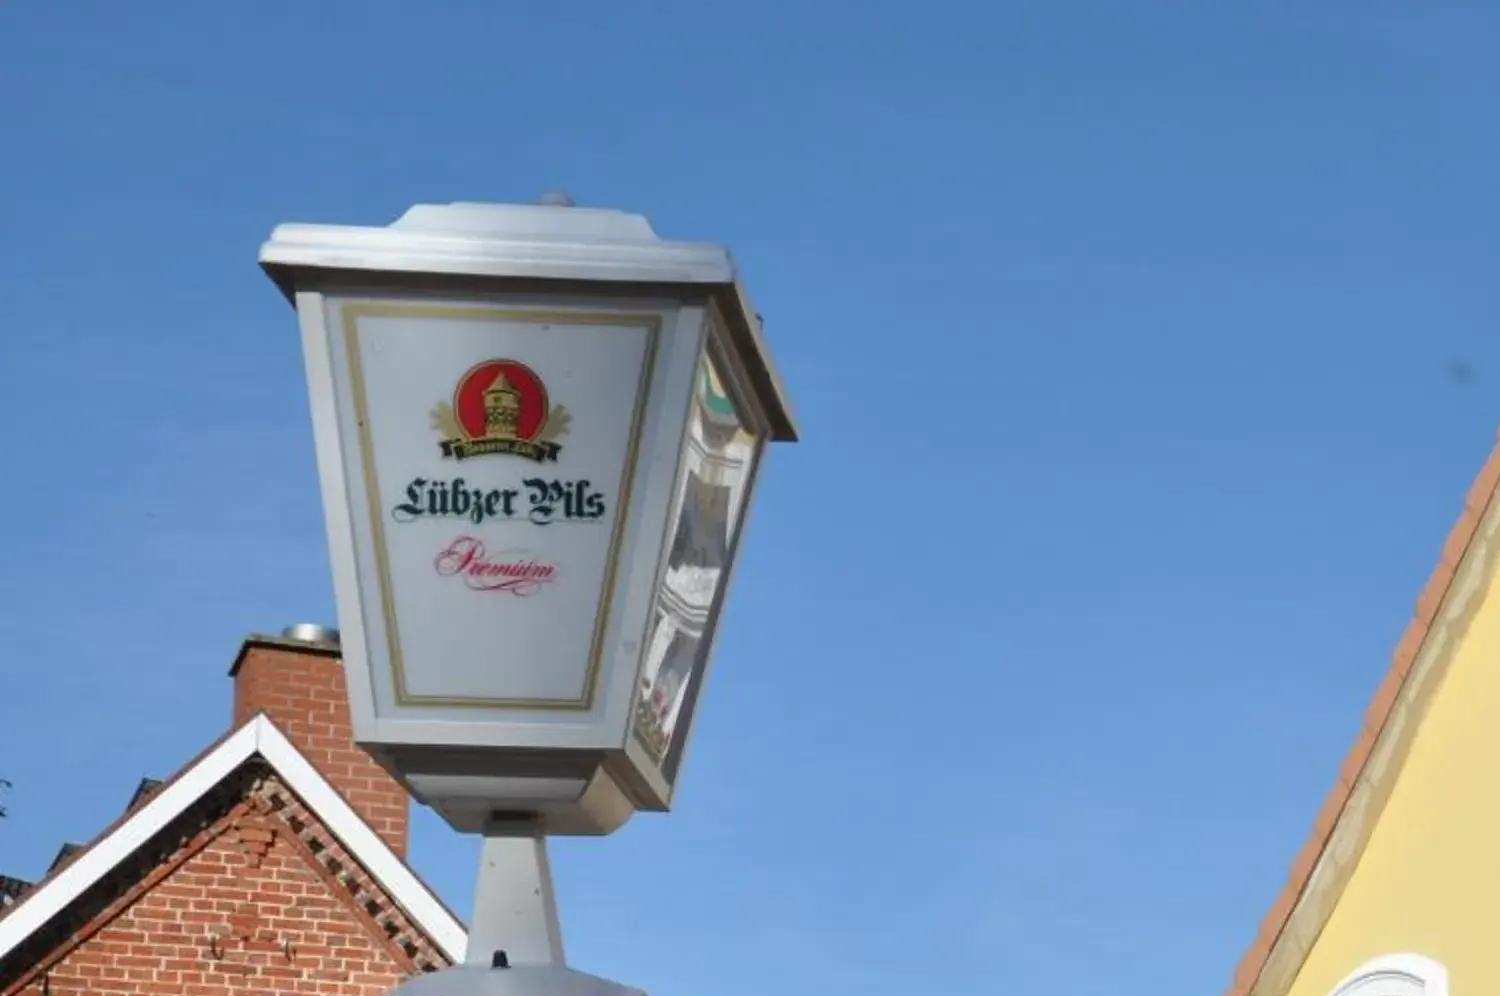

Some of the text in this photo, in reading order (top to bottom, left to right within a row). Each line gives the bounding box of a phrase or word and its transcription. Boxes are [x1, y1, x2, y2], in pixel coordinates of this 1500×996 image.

[392, 477, 606, 526] Lübzer Pils
[434, 535, 557, 596] Premium
